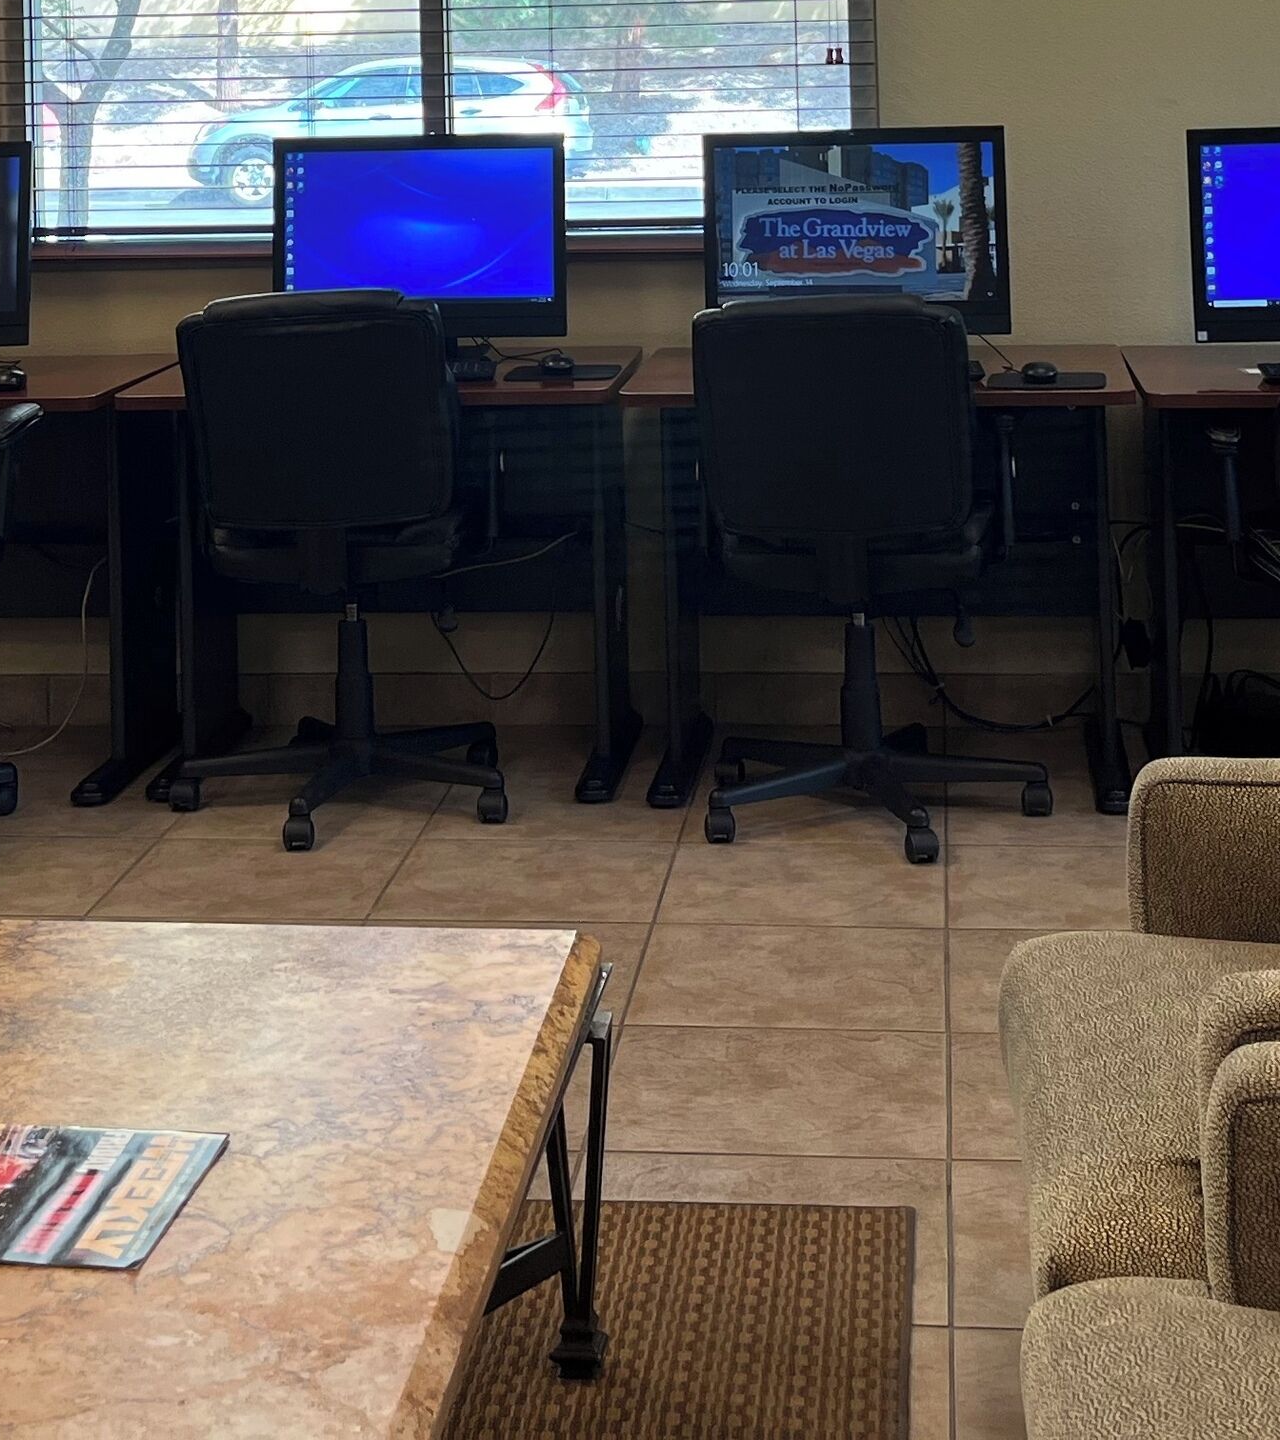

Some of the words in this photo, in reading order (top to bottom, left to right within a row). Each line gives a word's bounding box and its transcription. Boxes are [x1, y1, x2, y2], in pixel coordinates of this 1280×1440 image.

[736, 186, 772, 194] PLEASE
[772, 185, 805, 193] SELECT
[808, 185, 827, 193] THE
[767, 198, 812, 206] ACCOUNT
[829, 196, 858, 204] LOGIN
[759, 217, 800, 237] The
[803, 217, 912, 237] Grandview
[779, 244, 799, 259] at
[801, 239, 835, 259] Las
[838, 239, 894, 263] Vegas
